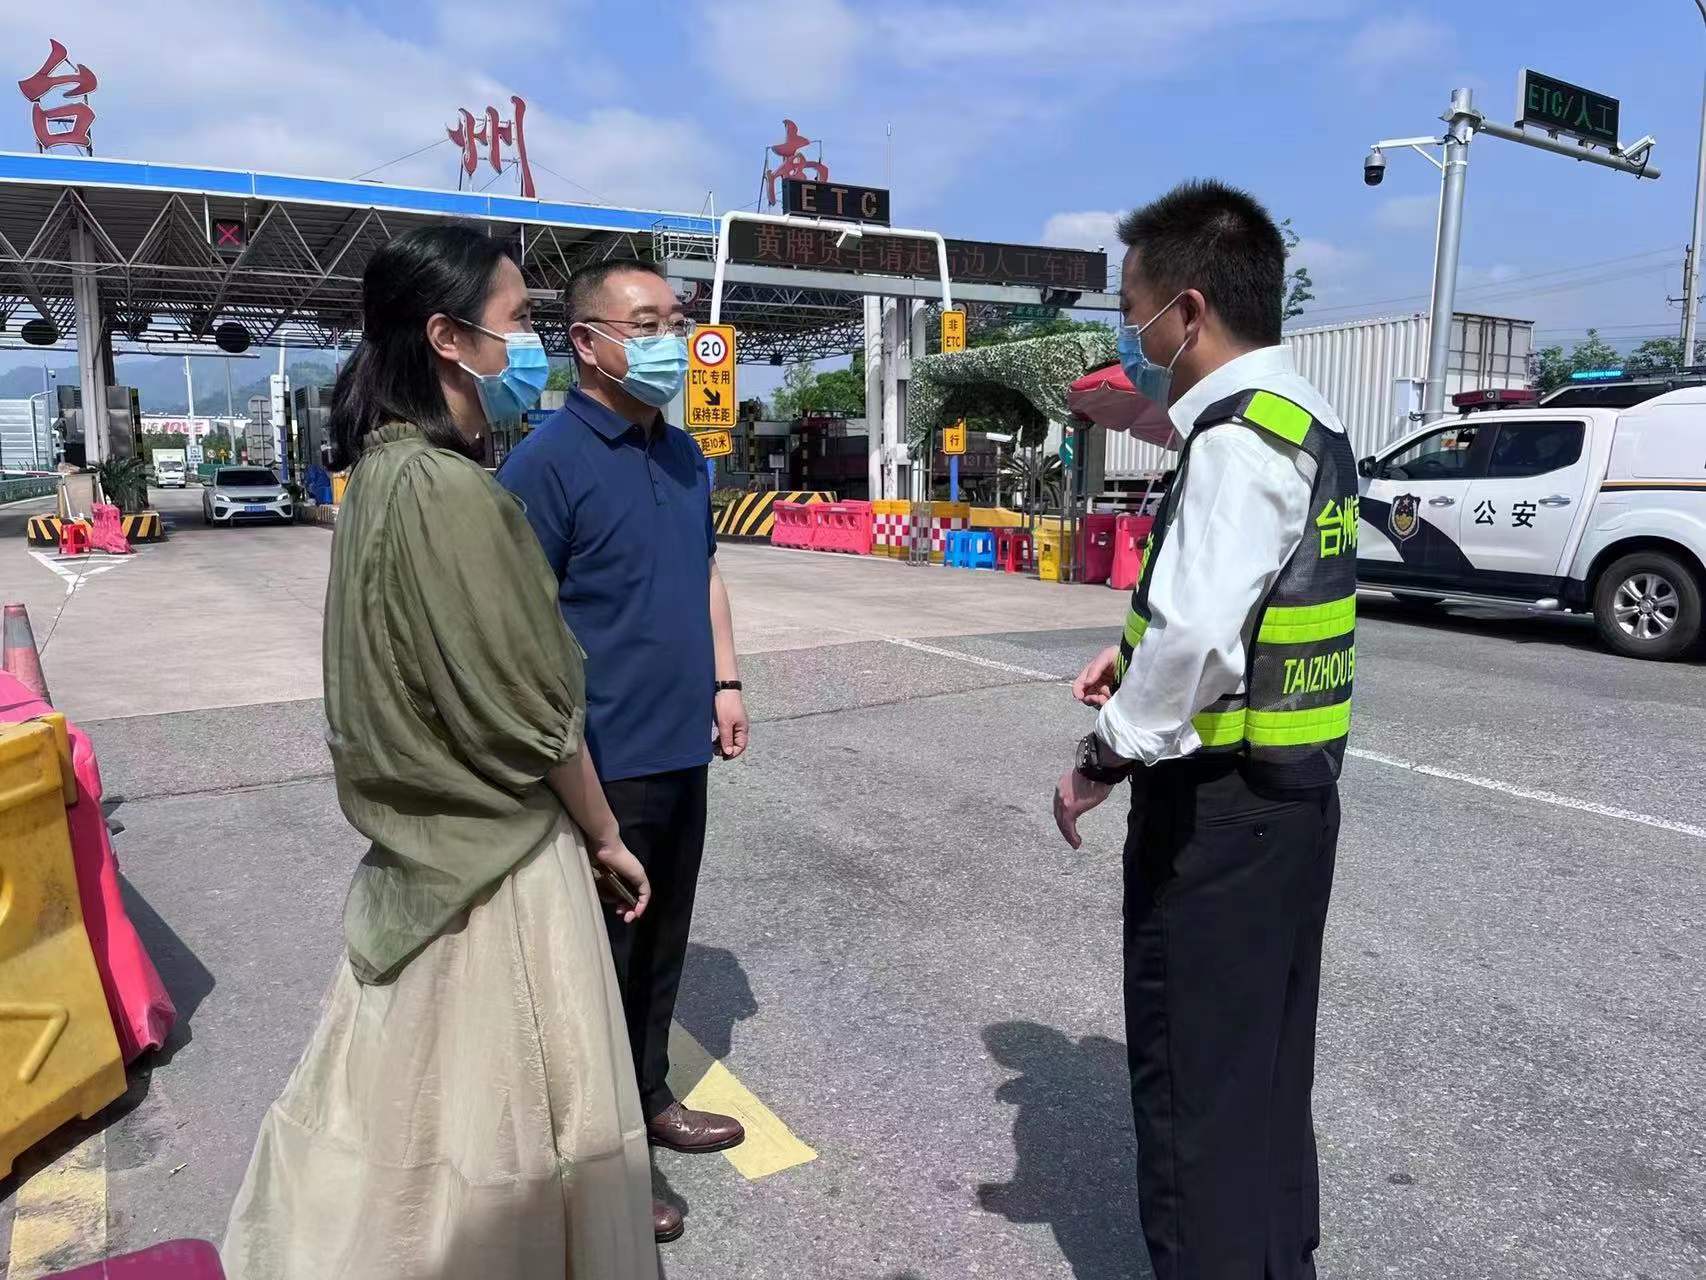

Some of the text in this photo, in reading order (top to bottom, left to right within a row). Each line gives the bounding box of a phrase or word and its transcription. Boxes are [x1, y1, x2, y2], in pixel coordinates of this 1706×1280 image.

[18, 38, 99, 150] 台
[446, 96, 536, 198] 州
[801, 184, 878, 218] ETC
[701, 342, 721, 356] 20
[946, 336, 961, 347] ETC
[692, 370, 730, 385] ETC 专用
[693, 407, 730, 422] 保持车距
[1473, 500, 1537, 528] 公安
